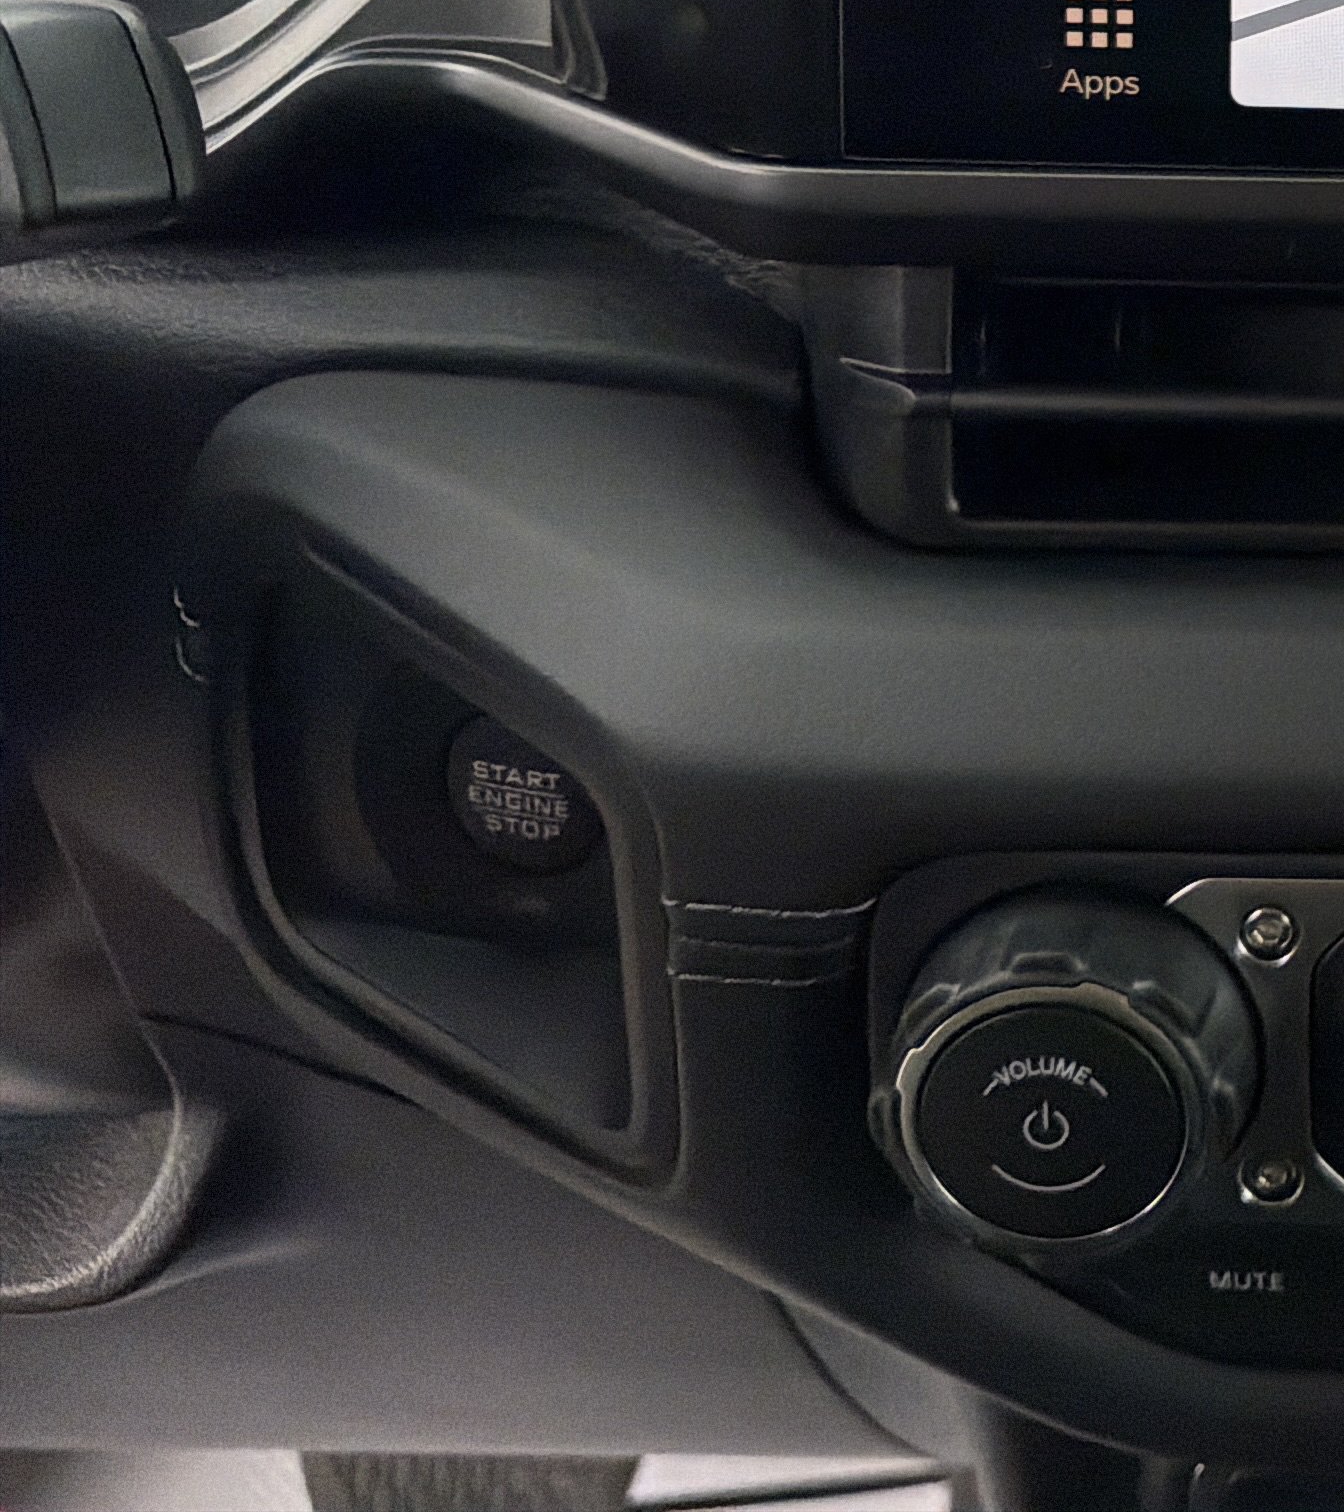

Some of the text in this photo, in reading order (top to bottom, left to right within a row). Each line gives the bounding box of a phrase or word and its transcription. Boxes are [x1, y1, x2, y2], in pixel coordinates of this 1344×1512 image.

[1060, 68, 1140, 101] Apps
[473, 759, 560, 790] START
[468, 784, 569, 819] ENGINE
[485, 813, 560, 840] STOP
[995, 1056, 1091, 1085] VOLUME
[1209, 1271, 1284, 1292] MUTE
